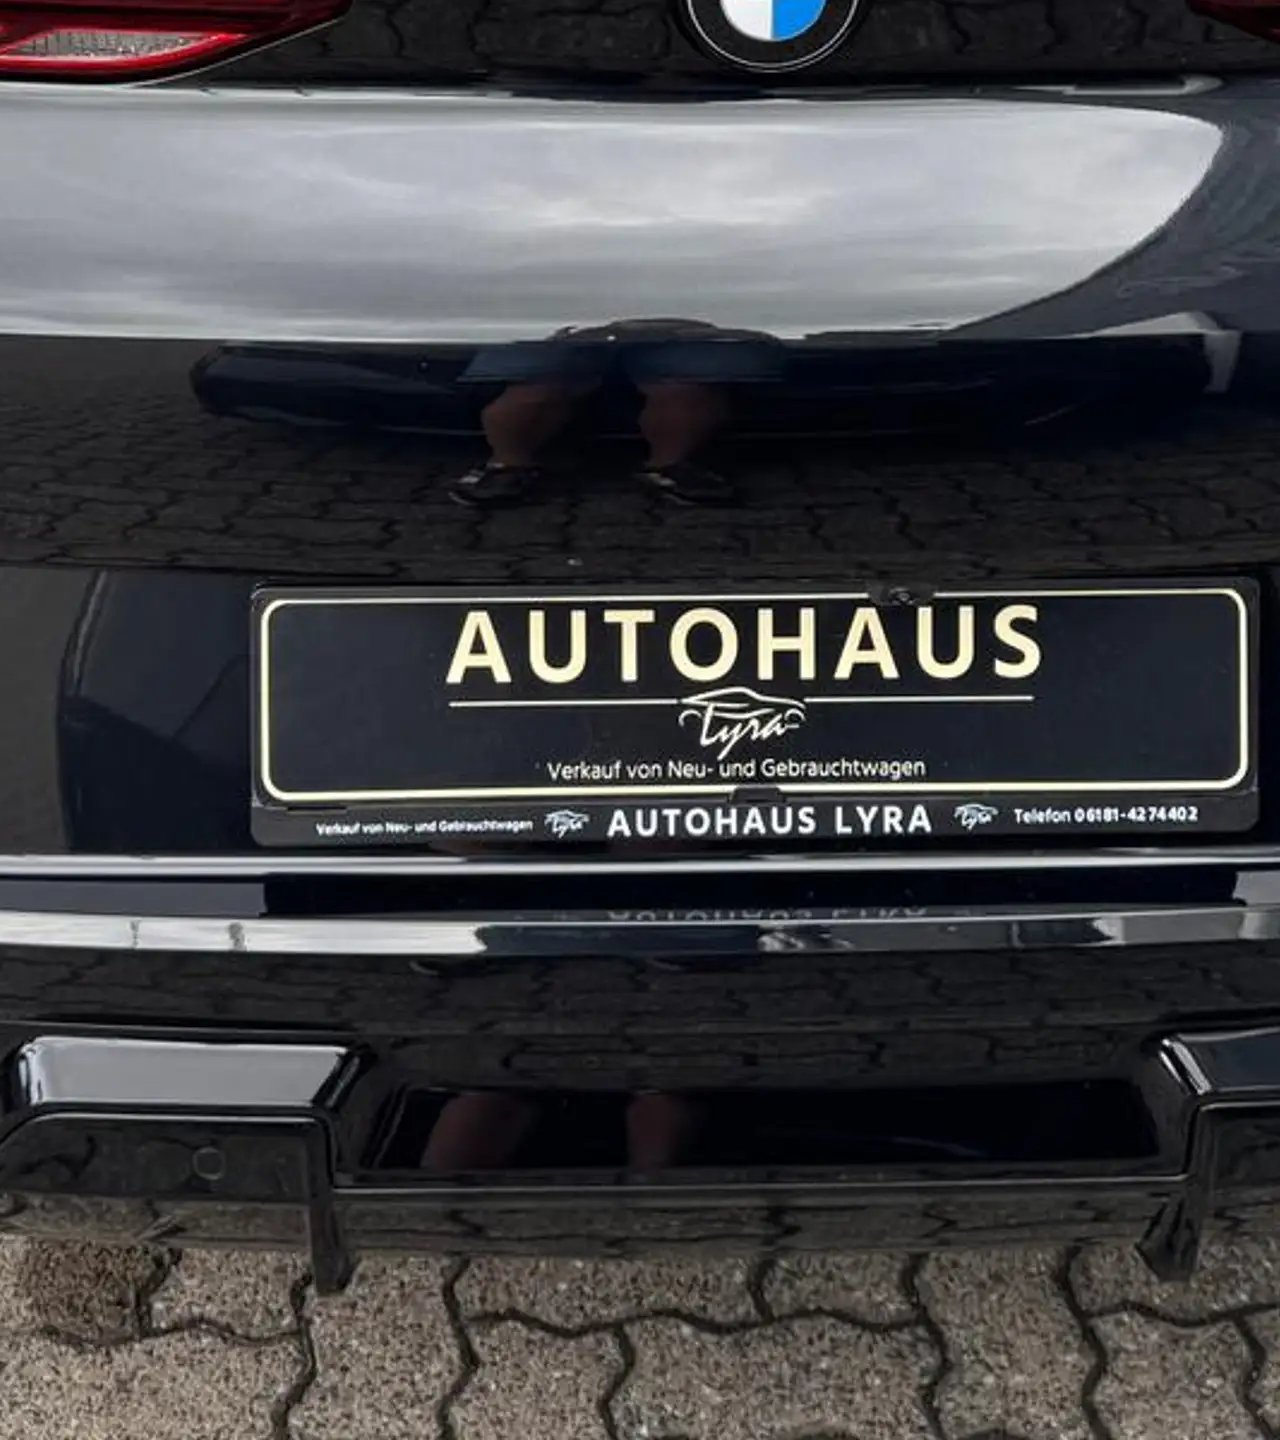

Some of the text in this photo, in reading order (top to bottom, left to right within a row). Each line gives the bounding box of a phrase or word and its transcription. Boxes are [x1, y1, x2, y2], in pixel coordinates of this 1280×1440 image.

[445, 604, 1043, 685] AUTOHAUS
[698, 704, 790, 761] Lyra
[548, 758, 925, 781] Verkauf von Neu- und Gebrauchtwagen
[316, 822, 360, 835] Verkauf
[362, 824, 384, 834] von
[386, 822, 412, 833] Neu-
[415, 821, 437, 833] und
[439, 820, 533, 833] Gebrauchtwagen
[607, 806, 817, 837] AUTOHAUS
[835, 804, 932, 834] LYRA
[1014, 808, 1070, 823] Telefon
